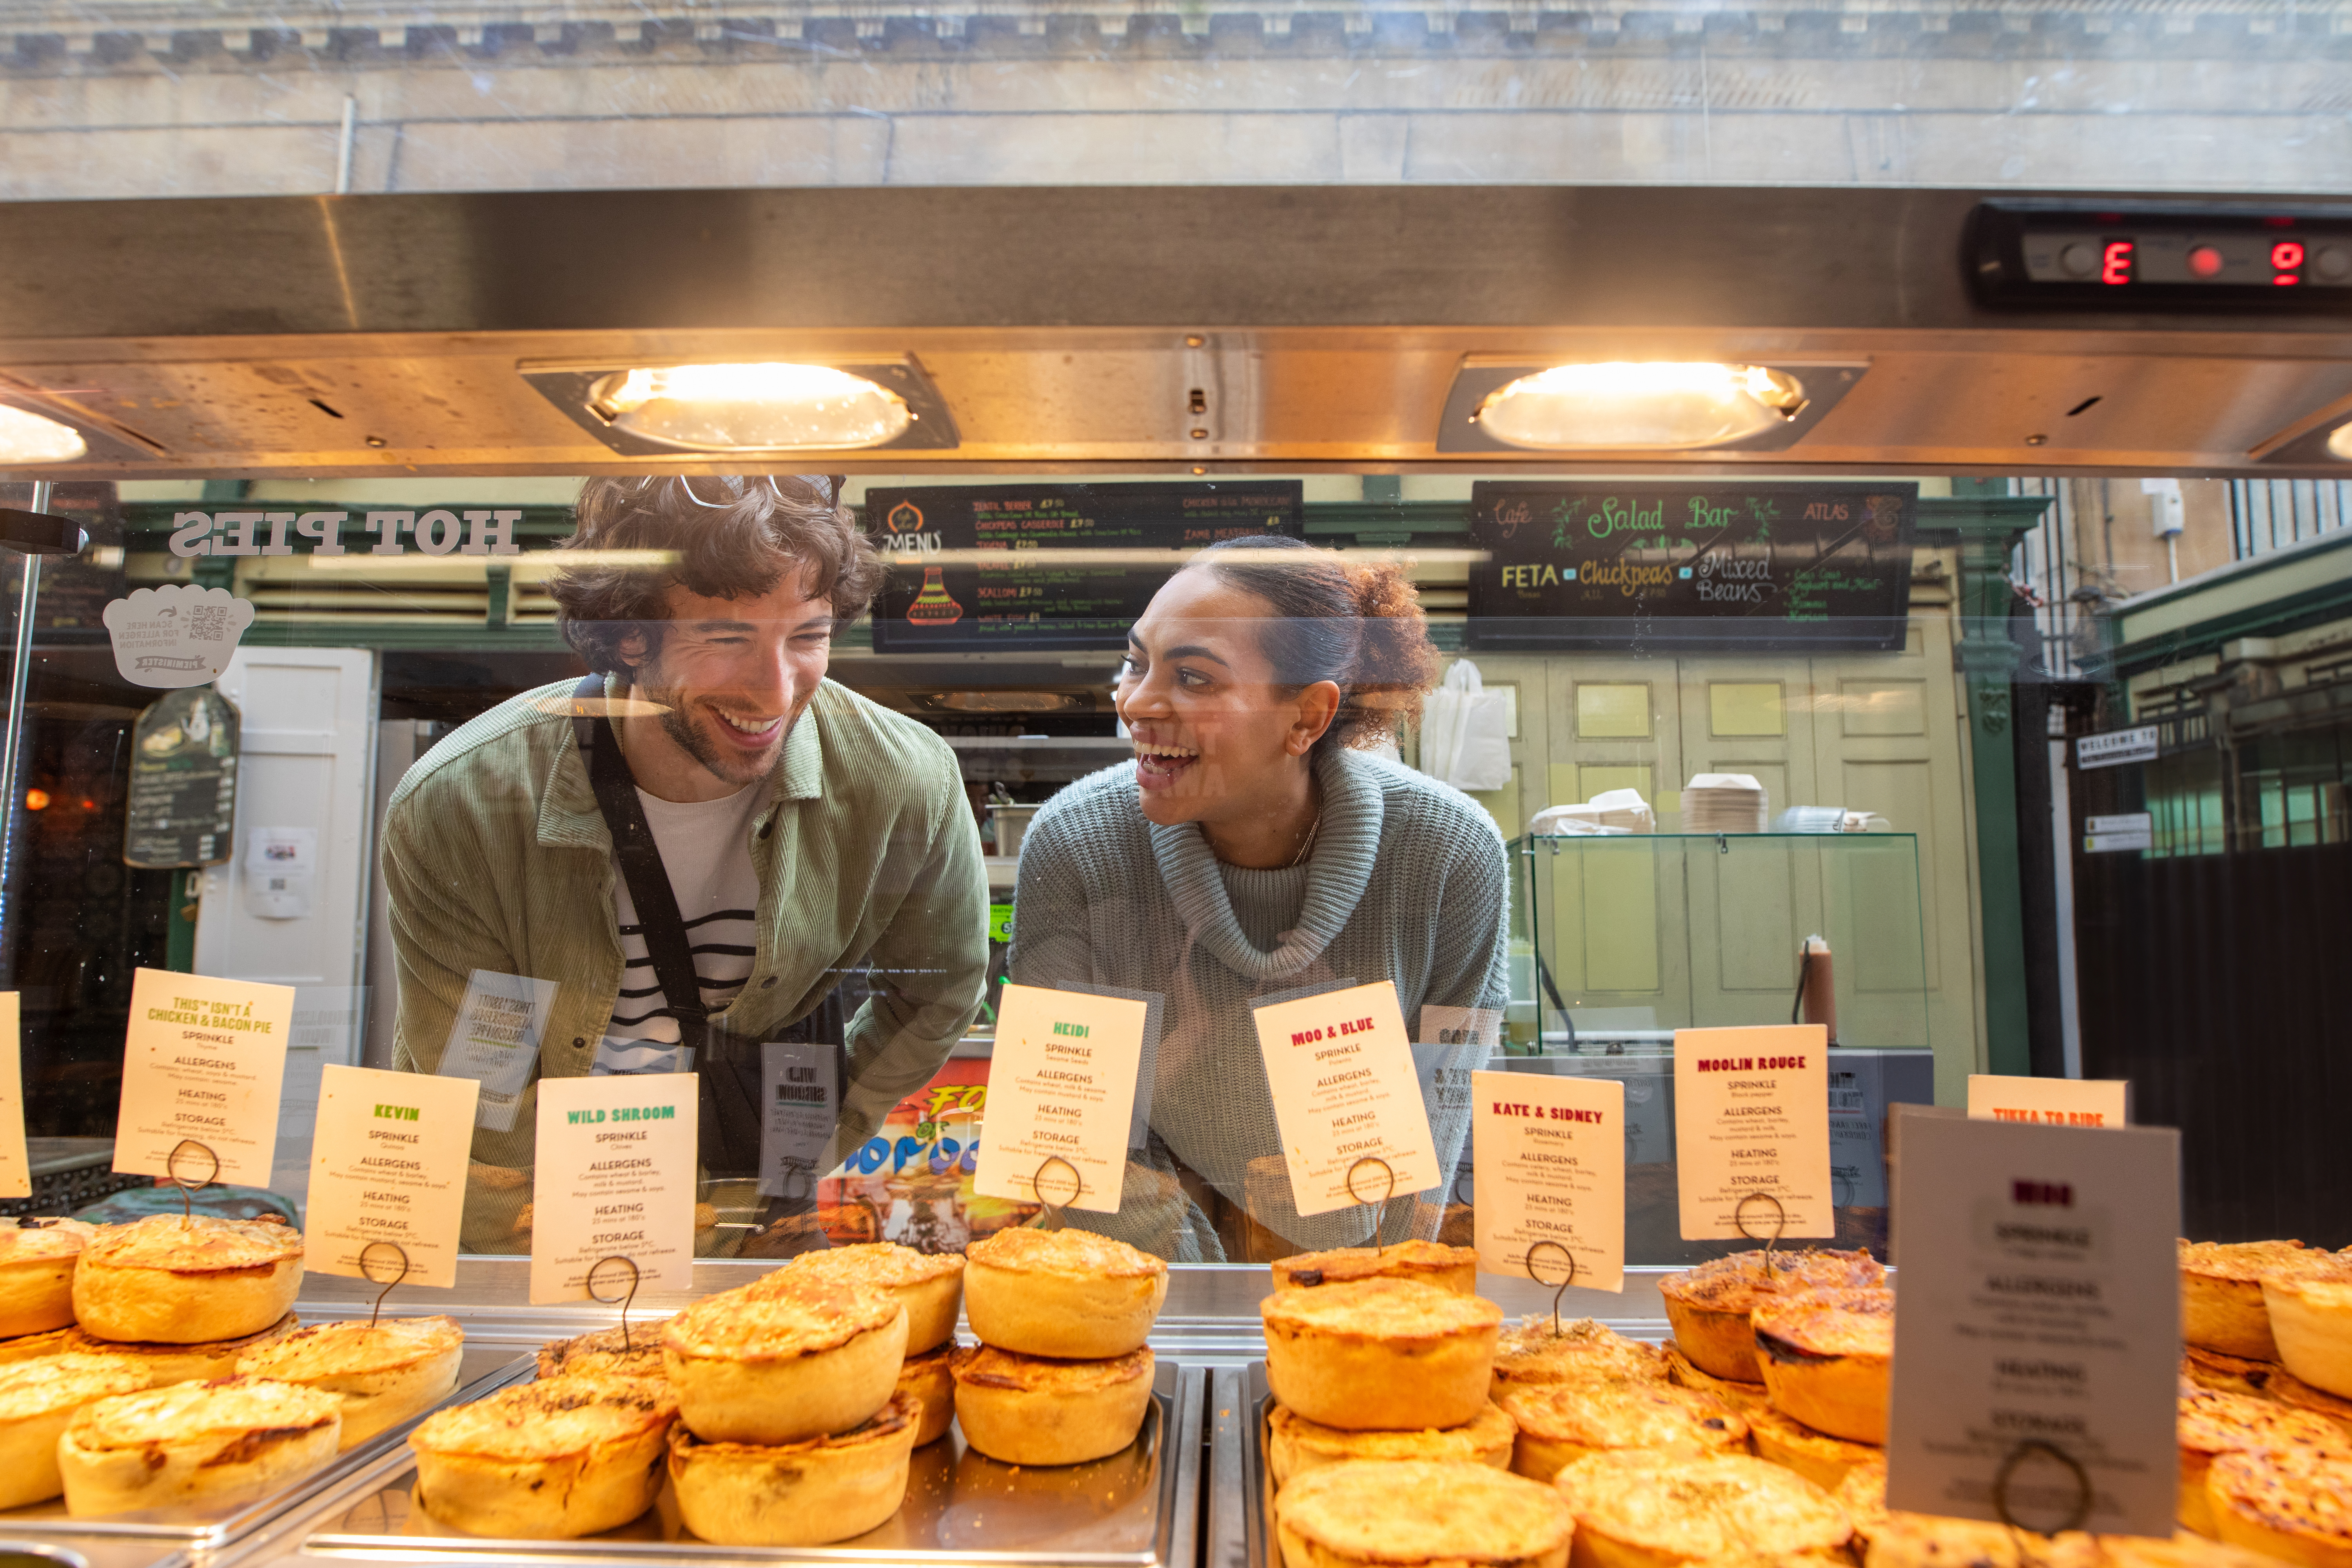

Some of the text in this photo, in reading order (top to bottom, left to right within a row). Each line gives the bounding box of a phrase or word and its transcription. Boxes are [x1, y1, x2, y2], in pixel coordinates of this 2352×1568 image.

[1588, 496, 1738, 538] Salad Bar
[1804, 503, 1849, 521] ATLAS
[883, 532, 942, 555] MENU
[1699, 548, 1773, 579] Mixed
[1502, 564, 1559, 588] FETA
[1579, 557, 1673, 597] Chickpeas
[1696, 579, 1778, 603] Beans
[210, 1002, 241, 1016] ISN'T
[242, 1004, 252, 1017] A
[147, 1007, 272, 1034] CHICKEN & BACON PIE
[182, 1031, 234, 1045] SPRINKLE
[1053, 1022, 1090, 1039] HEIDI
[1291, 1017, 1374, 1046] MOO & BLUE
[1045, 1043, 1092, 1058] SPRINKLE
[1315, 1043, 1361, 1061] SPRINKLE
[174, 1056, 236, 1070] ALLERGENS
[1698, 1056, 1806, 1072] MOOLIN ROUGE
[1036, 1069, 1092, 1084] ALLERGENS
[1317, 1068, 1372, 1088] ALLERGENS
[1728, 1080, 1776, 1090] SPRINKLE
[178, 1089, 226, 1102] HEATING
[374, 1104, 419, 1121] KEVIN
[567, 1105, 674, 1124] WILD SHROOM
[1038, 1104, 1081, 1118] HEATING
[1493, 1102, 1602, 1124] KATE & SIDNEY
[1724, 1106, 1782, 1116] ALLERGENS
[2044, 1110, 2065, 1125] TO
[175, 1113, 225, 1126] STORAGE
[1332, 1111, 1376, 1128] HEATING
[368, 1130, 419, 1143] SPRINKLE
[595, 1131, 647, 1143] SPRINKLE
[1033, 1131, 1079, 1145] STORAGE
[1524, 1127, 1573, 1140] SPRINKLE
[1336, 1137, 1383, 1155] STORAGE
[1731, 1149, 1777, 1158] HEATING
[360, 1157, 420, 1170] ALLERGENS
[589, 1158, 651, 1171] ALLERGENS
[1520, 1152, 1578, 1166] ALLERGENS
[1731, 1175, 1779, 1185] STORAGE
[363, 1191, 410, 1204] HEATING
[1527, 1194, 1572, 1207] HEATING
[595, 1203, 643, 1215] HEATING
[359, 1217, 408, 1230] STORAGE
[1525, 1219, 1572, 1234] STORAGE
[592, 1230, 644, 1244] STORAGE
